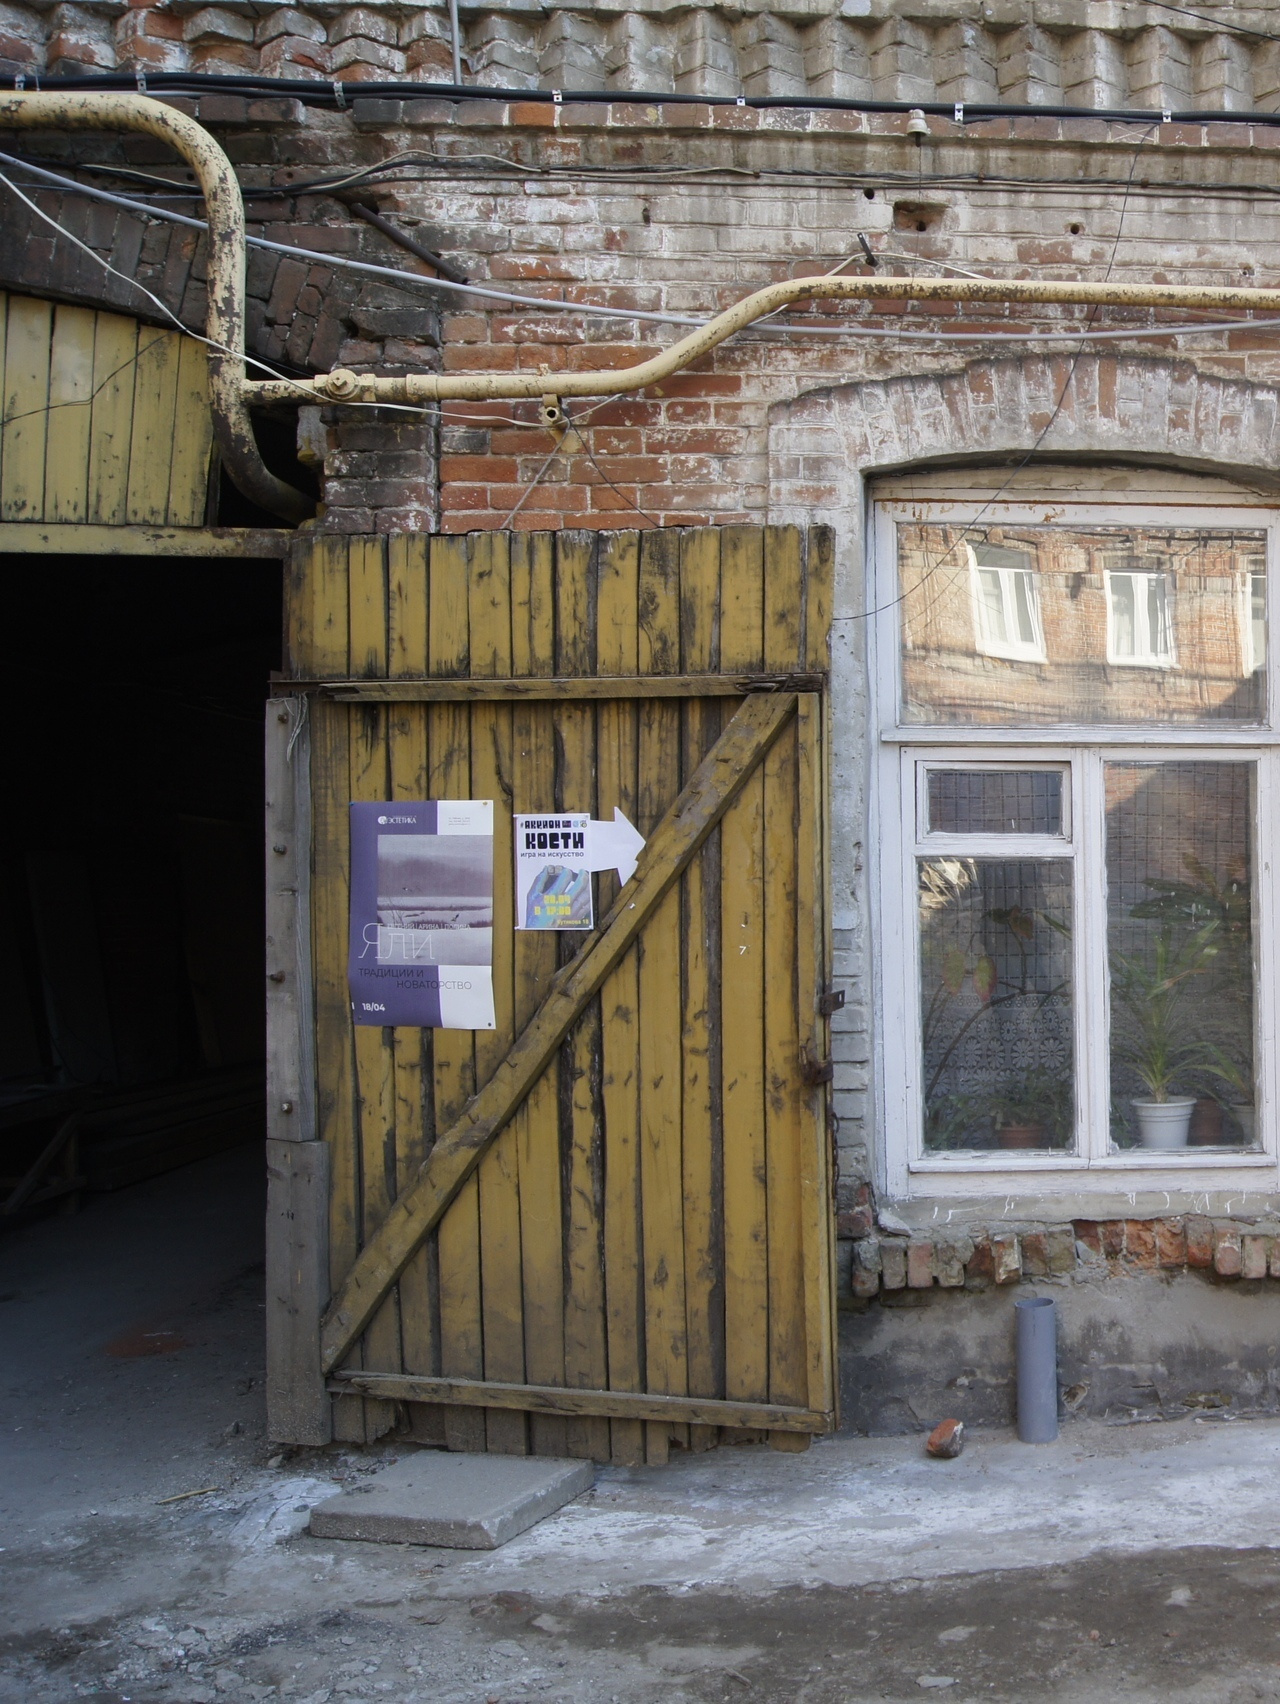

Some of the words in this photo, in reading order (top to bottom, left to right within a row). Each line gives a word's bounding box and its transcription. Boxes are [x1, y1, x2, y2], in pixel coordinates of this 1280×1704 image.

[525, 832, 584, 849] КОСТИ
[548, 851, 584, 859] искусство
[358, 968, 414, 979] ТРАДИЦИИ
[416, 969, 424, 977] И
[396, 980, 473, 990] НОВАТОРСТВО
[362, 1002, 386, 1011] 18/04
